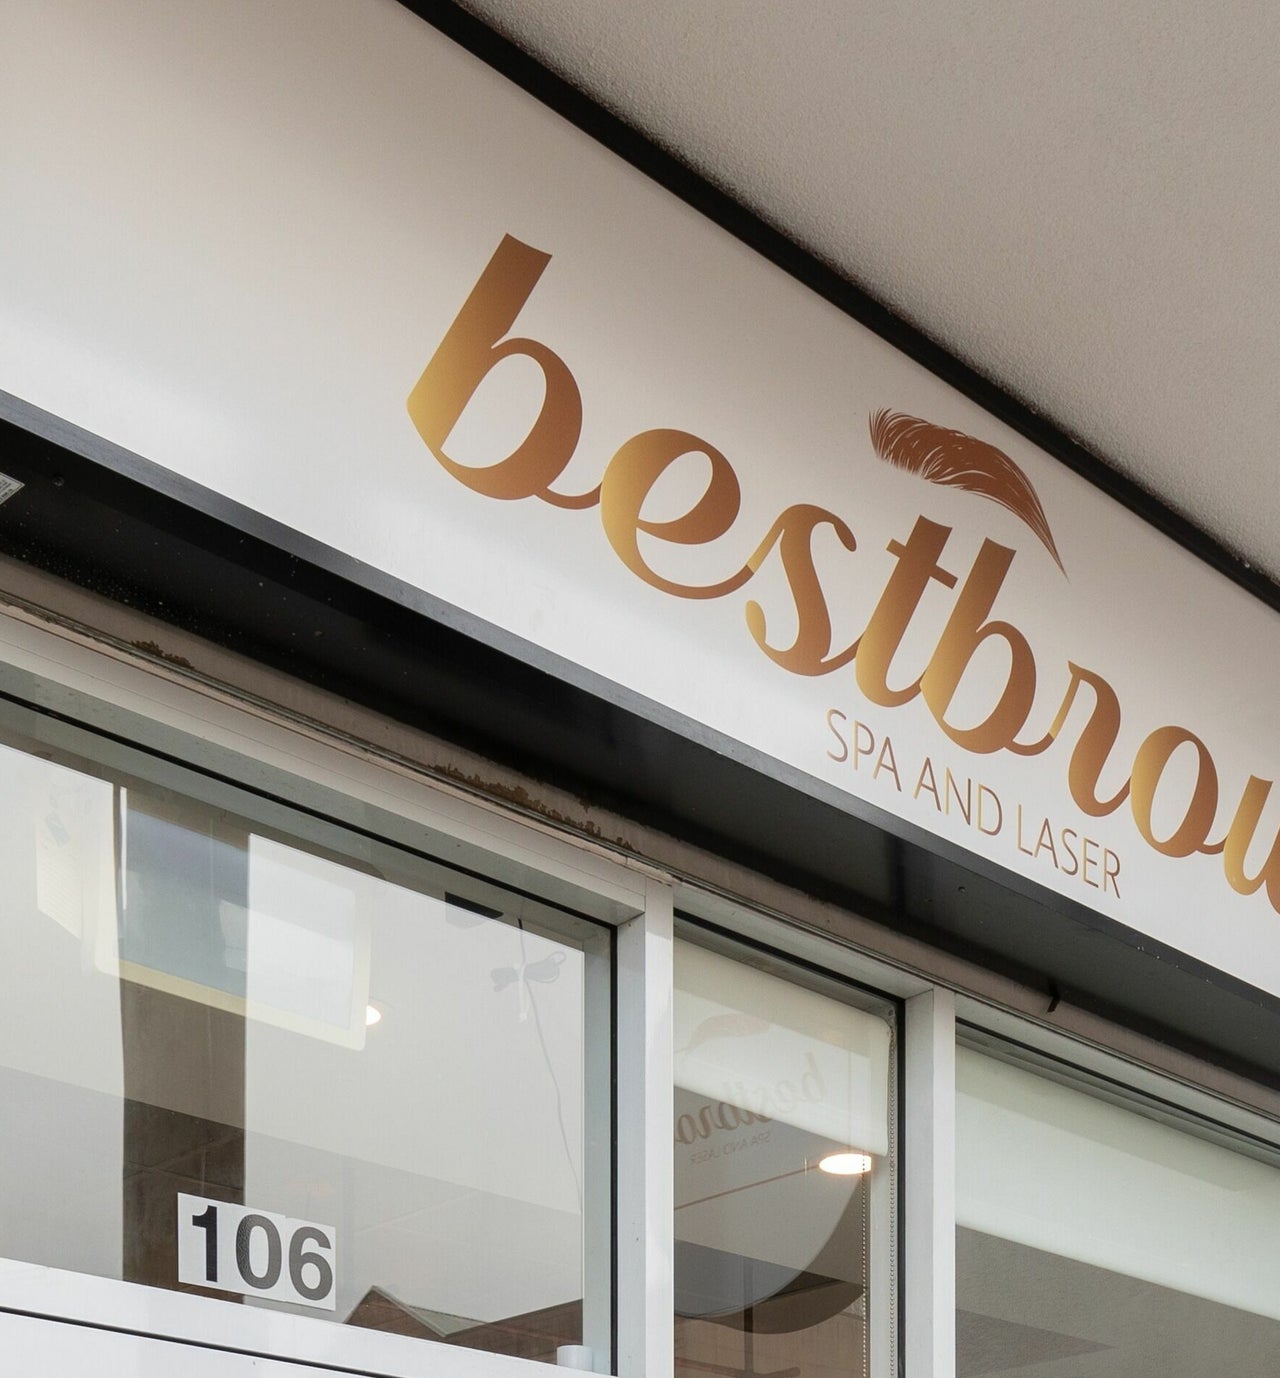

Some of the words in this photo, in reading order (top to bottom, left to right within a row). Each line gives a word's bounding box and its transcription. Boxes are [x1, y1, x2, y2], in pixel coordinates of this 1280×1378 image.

[824, 707, 904, 793] SPA
[913, 757, 1003, 837] AND
[1014, 801, 1123, 900] LASER
[191, 1205, 334, 1301] 106
